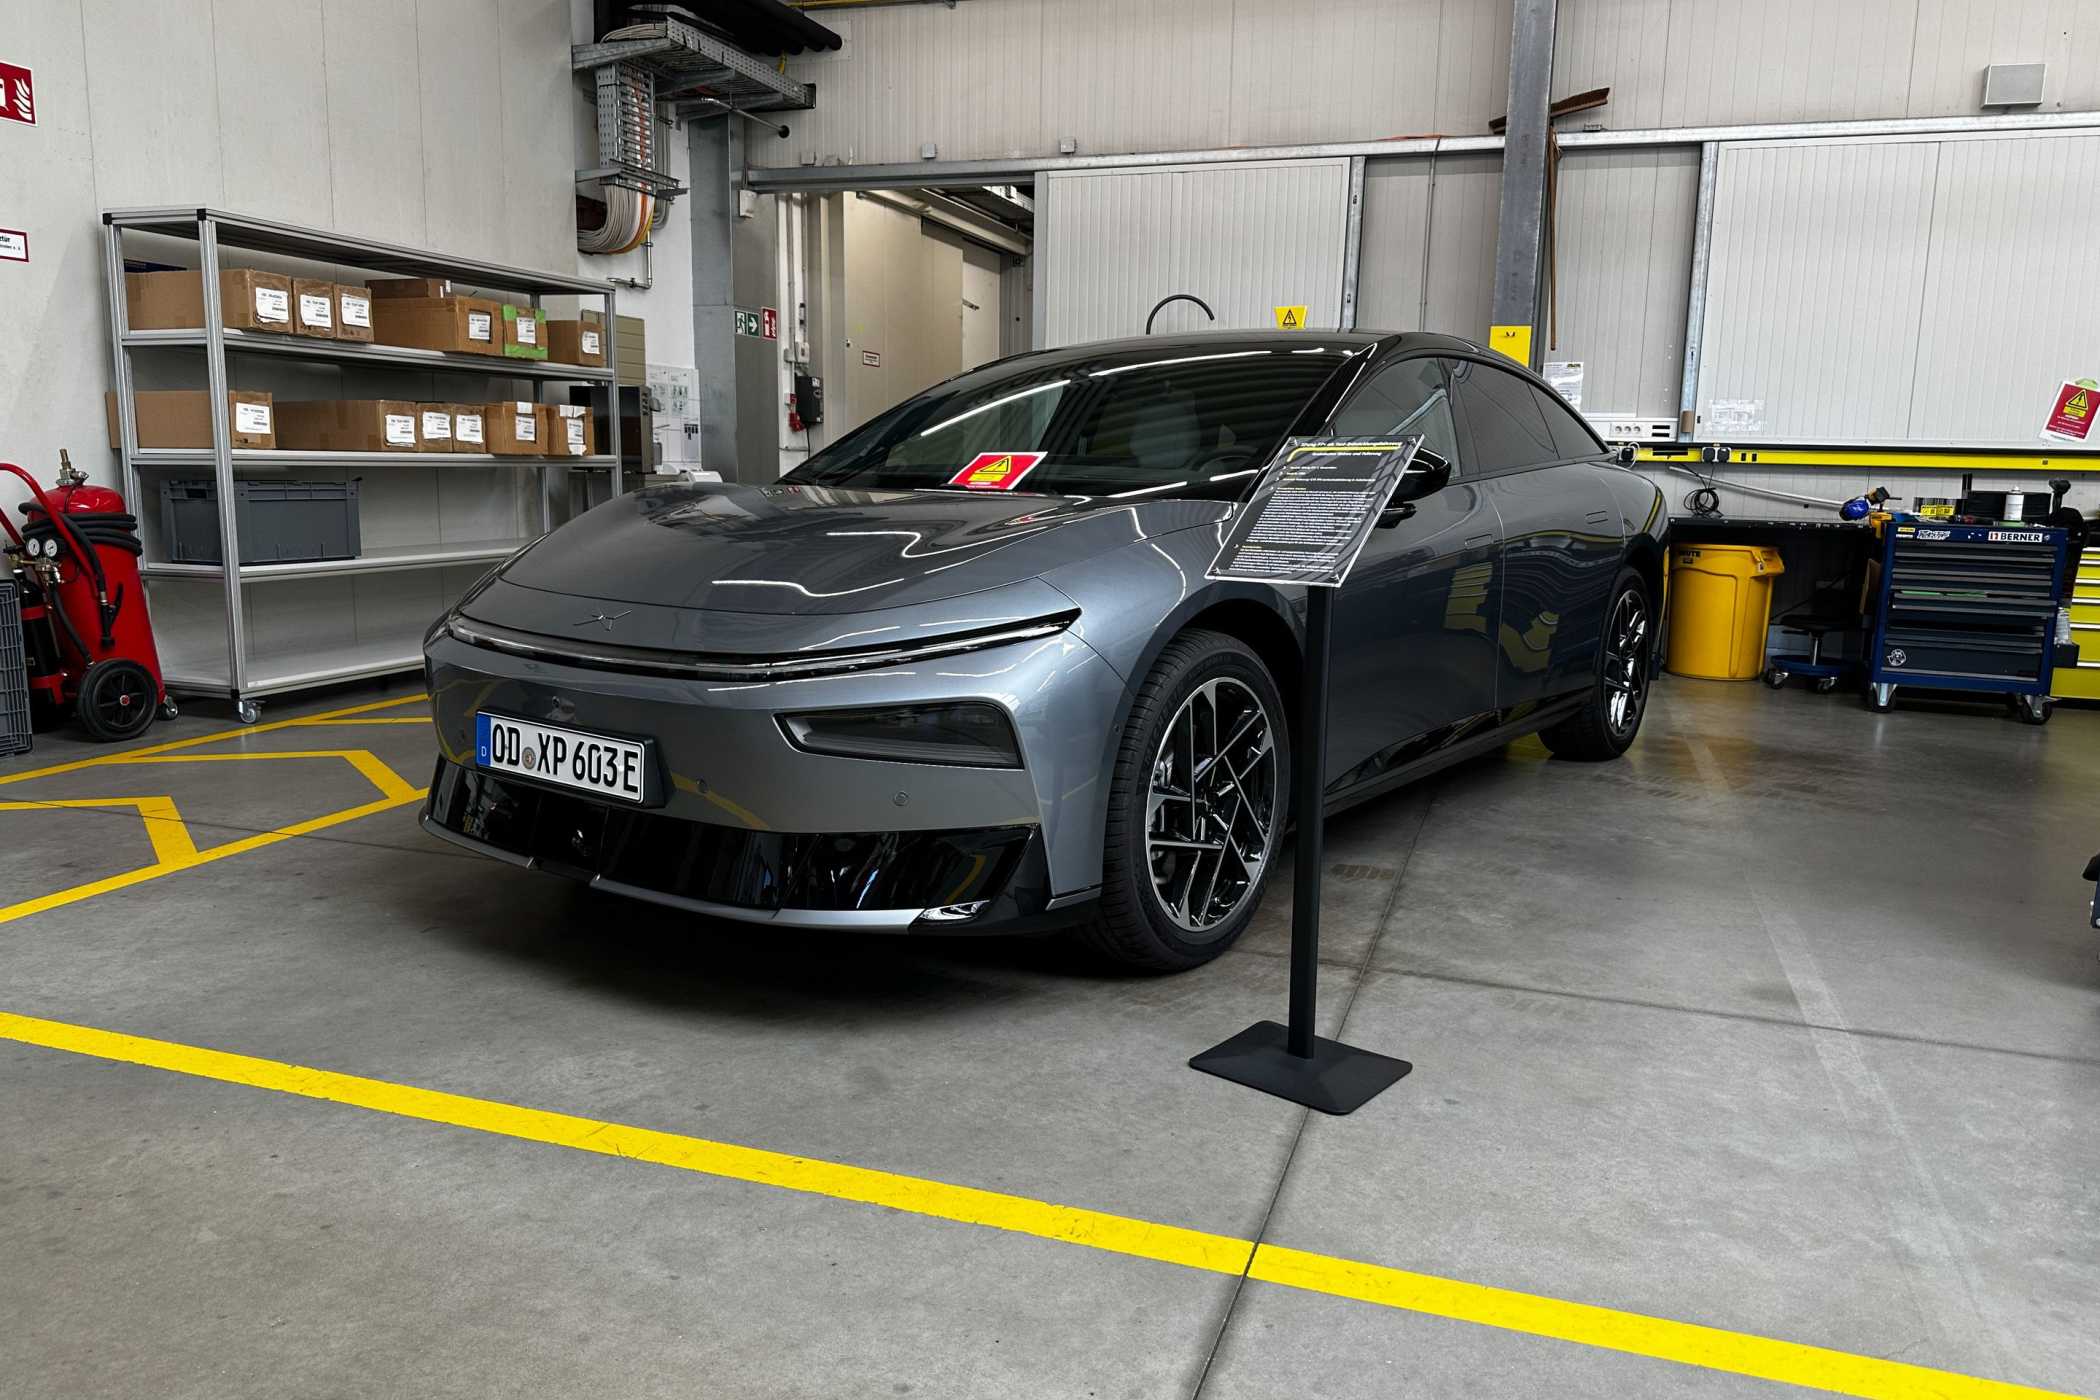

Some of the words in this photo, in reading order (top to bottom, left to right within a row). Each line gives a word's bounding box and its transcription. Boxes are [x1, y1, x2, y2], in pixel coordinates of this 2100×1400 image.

[2000, 532, 2041, 541] BERNER
[481, 745, 487, 757] D
[492, 723, 521, 766] OD
[536, 732, 567, 776] XP
[572, 741, 639, 794] 603E
